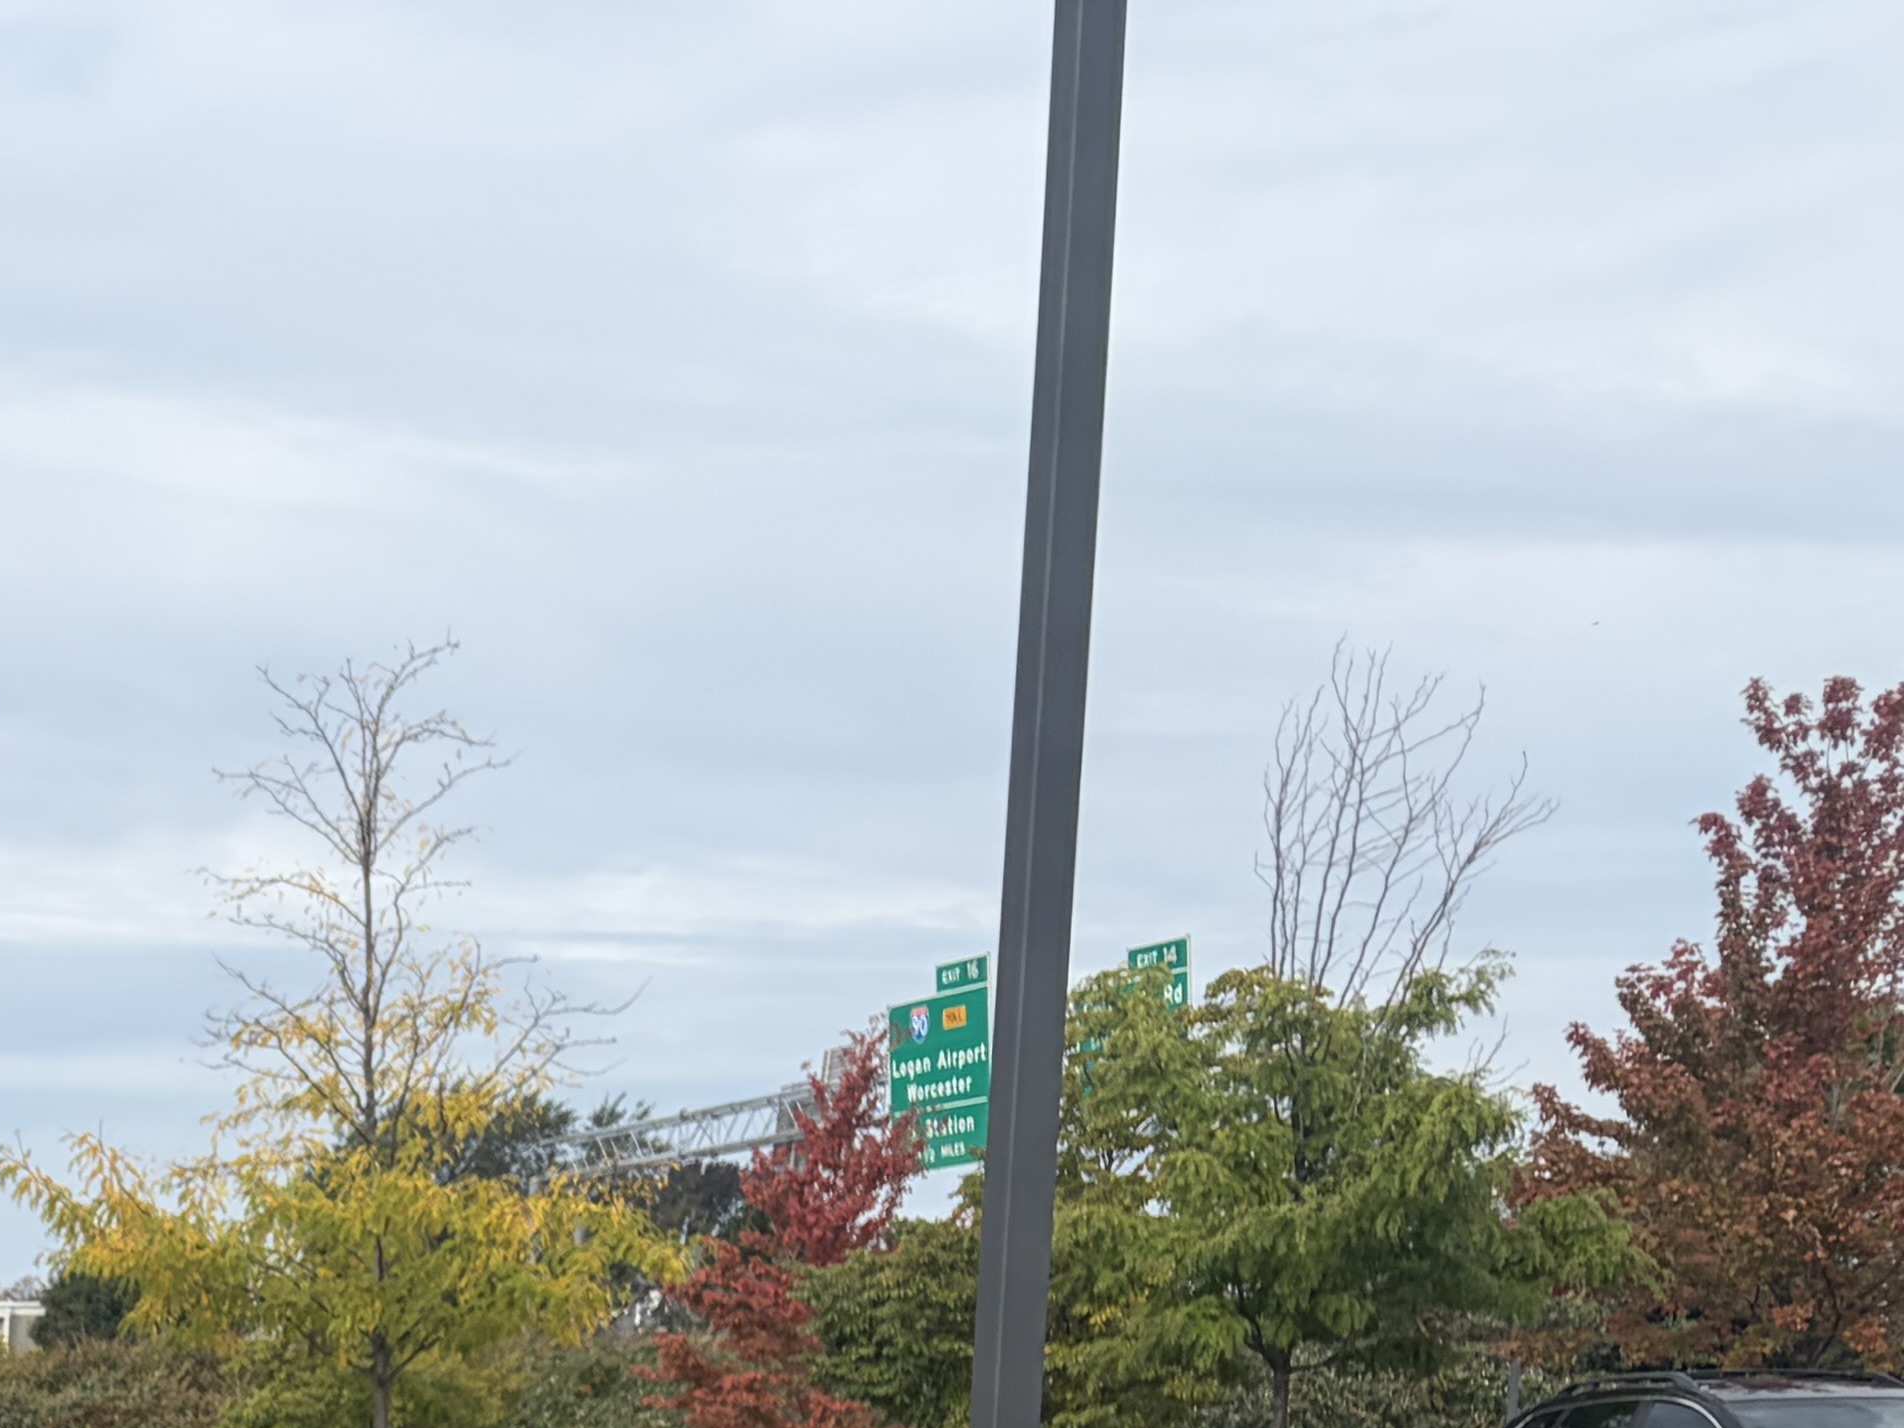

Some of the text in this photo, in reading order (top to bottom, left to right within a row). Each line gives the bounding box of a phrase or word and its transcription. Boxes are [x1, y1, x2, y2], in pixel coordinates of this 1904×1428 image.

[1136, 944, 1177, 969] EXIT 14
[941, 959, 979, 985] EXIT 16
[912, 1015, 928, 1037] 90
[892, 1042, 986, 1081] Logan Airport
[907, 1076, 972, 1102] Worcester
[926, 1115, 975, 1139] Station
[941, 1140, 966, 1158] MILES
